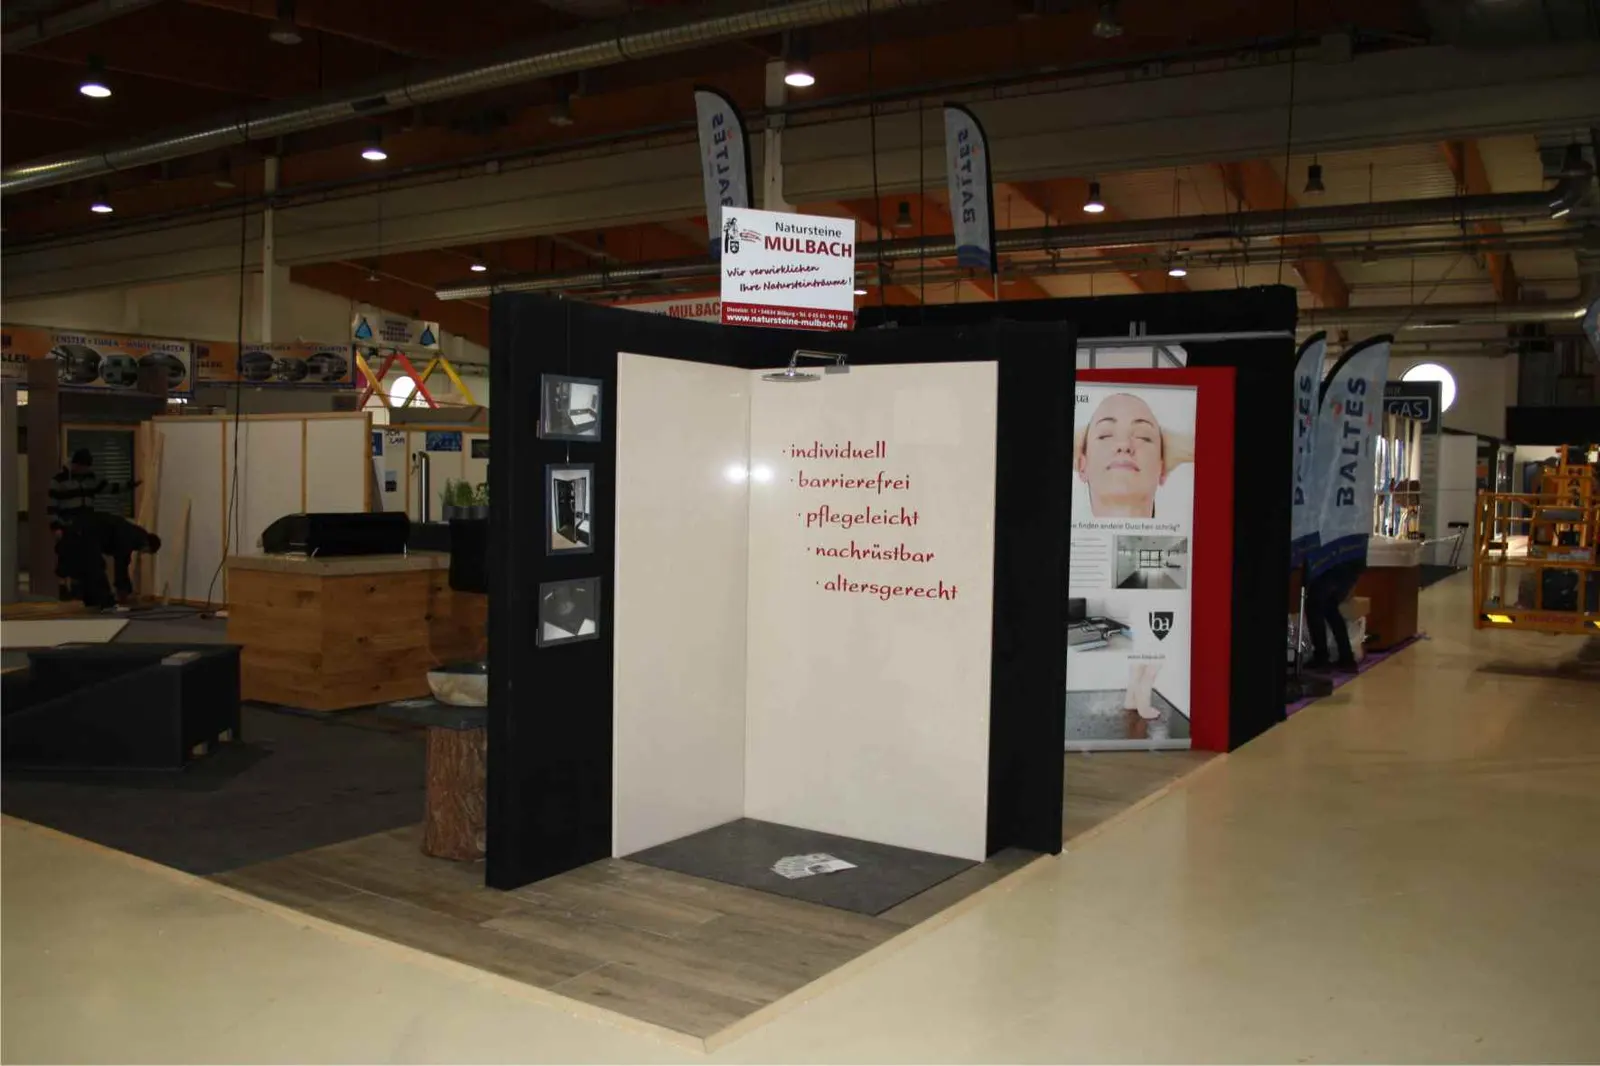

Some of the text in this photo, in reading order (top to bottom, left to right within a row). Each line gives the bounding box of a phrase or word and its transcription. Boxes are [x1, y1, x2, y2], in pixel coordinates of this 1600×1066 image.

[775, 221, 842, 238] Natursteine
[764, 235, 852, 258] MULBACH
[727, 264, 820, 277] Wir verwirklichen
[739, 283, 760, 292] Ihre
[669, 302, 721, 320] MULBAC
[727, 315, 848, 329] www.natursteine-mulbach.de
[791, 440, 886, 459] individuell
[1337, 377, 1367, 507] BALTES
[799, 471, 909, 494] barrierefrei
[806, 504, 919, 529] pflegeleicht
[1078, 521, 1099, 530] finden
[1100, 522, 1124, 530] andere
[816, 540, 935, 563] nachrüstbar
[824, 574, 958, 601] altersgerecht
